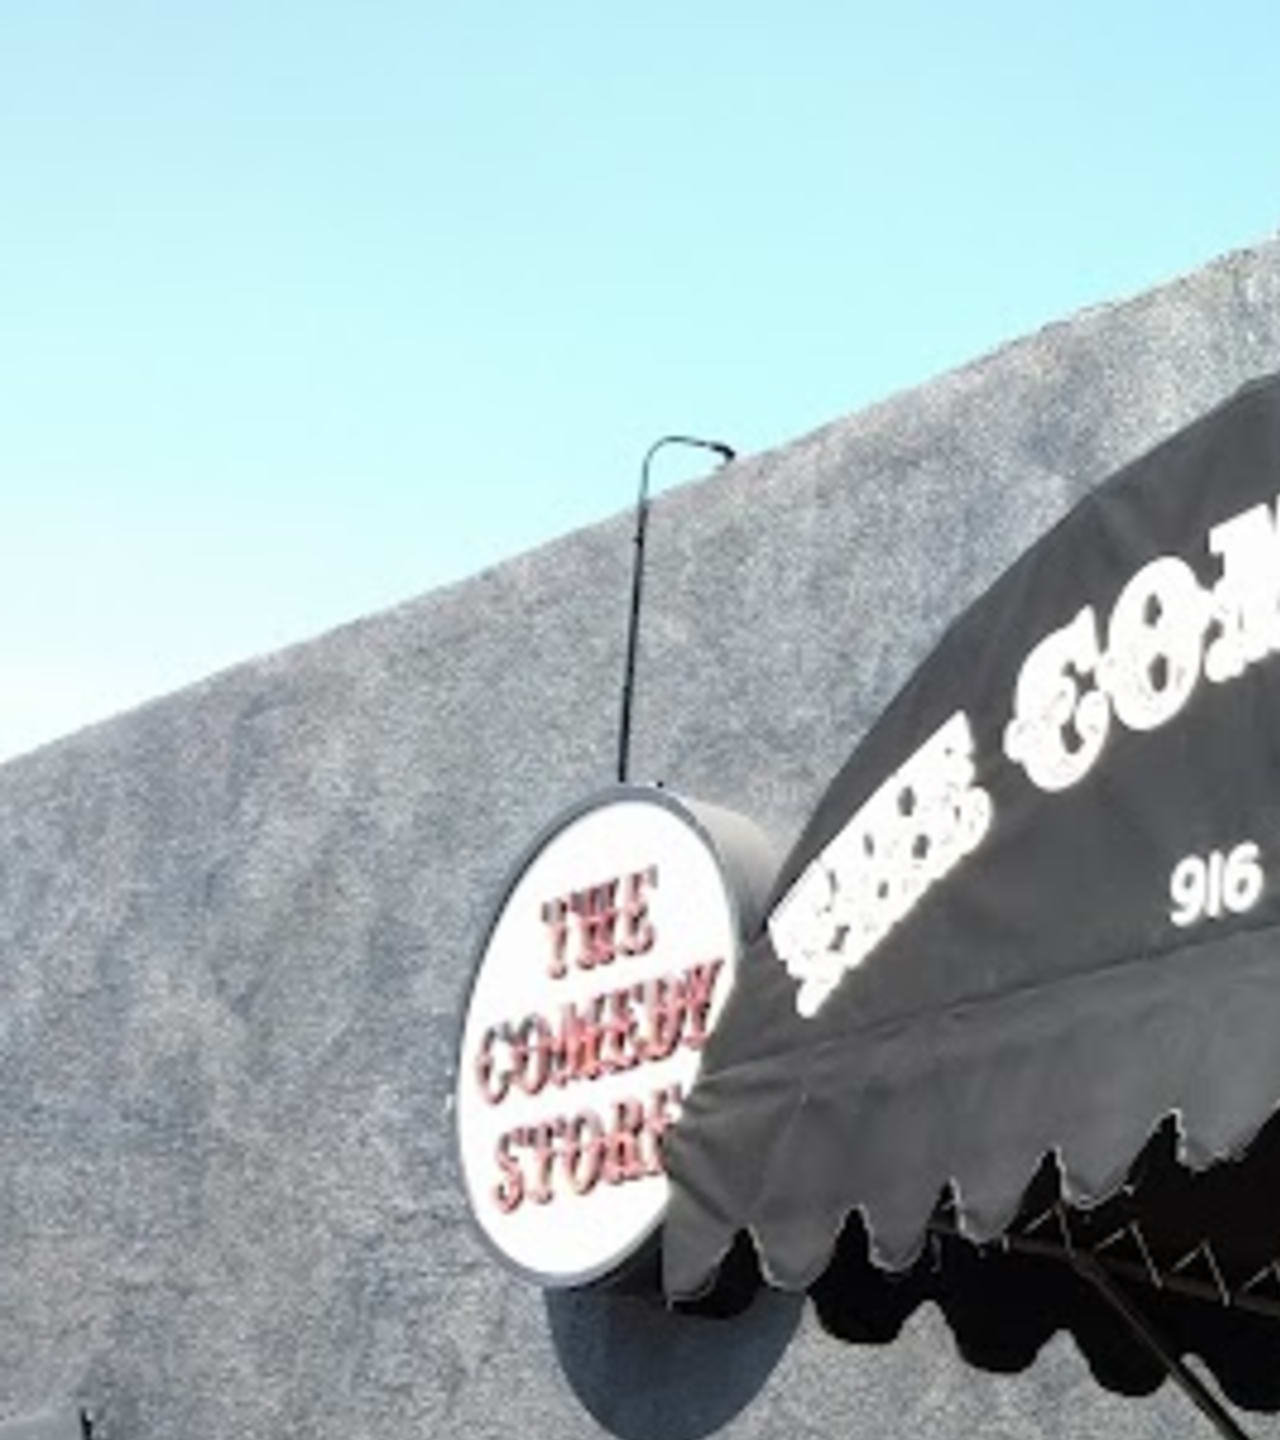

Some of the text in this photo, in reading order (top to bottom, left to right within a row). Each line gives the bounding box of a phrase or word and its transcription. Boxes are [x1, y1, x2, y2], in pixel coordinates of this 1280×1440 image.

[541, 864, 660, 980] THE
[767, 709, 994, 1018] THE
[1170, 842, 1265, 926] 916
[474, 958, 725, 1106] COMEDY
